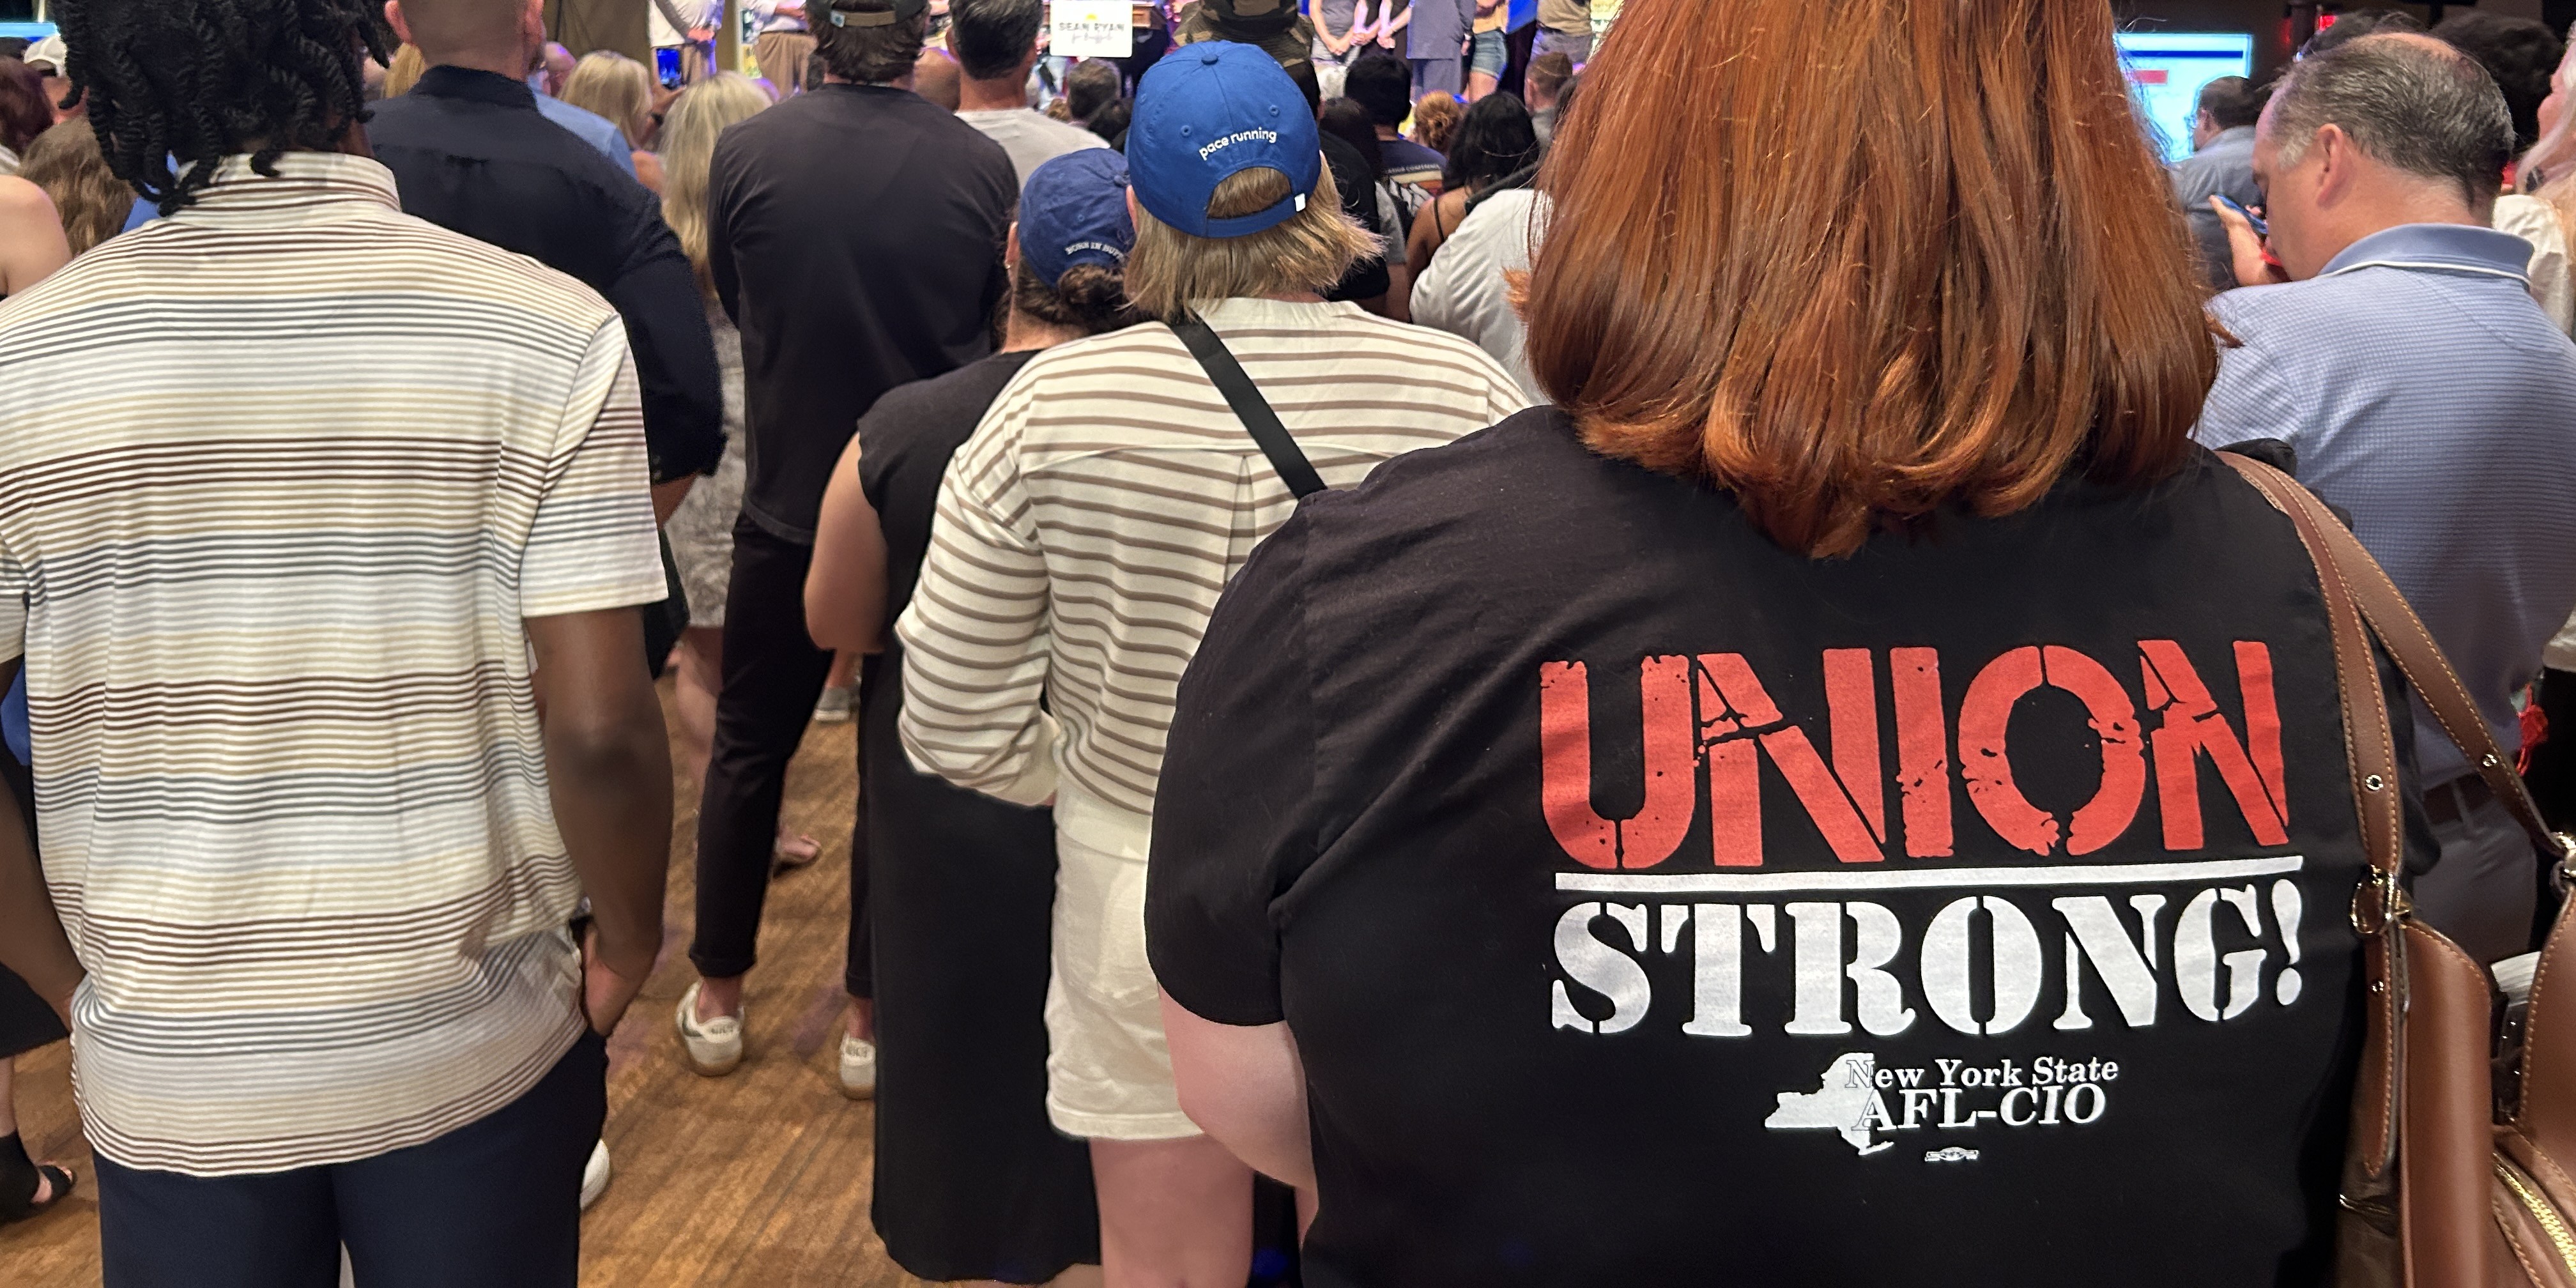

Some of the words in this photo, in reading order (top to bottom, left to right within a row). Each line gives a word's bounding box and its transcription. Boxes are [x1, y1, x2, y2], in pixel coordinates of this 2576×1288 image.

[1059, 22, 1089, 31] SEAN
[1094, 23, 1124, 31] RYAN
[1199, 137, 1229, 161] pace
[1230, 126, 1277, 144] running
[1065, 241, 1089, 255] BORN
[1090, 241, 1102, 250] IN
[1541, 640, 2288, 869] UNION
[1552, 878, 2302, 1036] STRONG!
[1845, 1059, 1924, 1089] New
[1935, 1059, 2023, 1087] York
[2031, 1056, 2119, 1085] State
[1851, 1083, 2106, 1131] AFL-CIO
